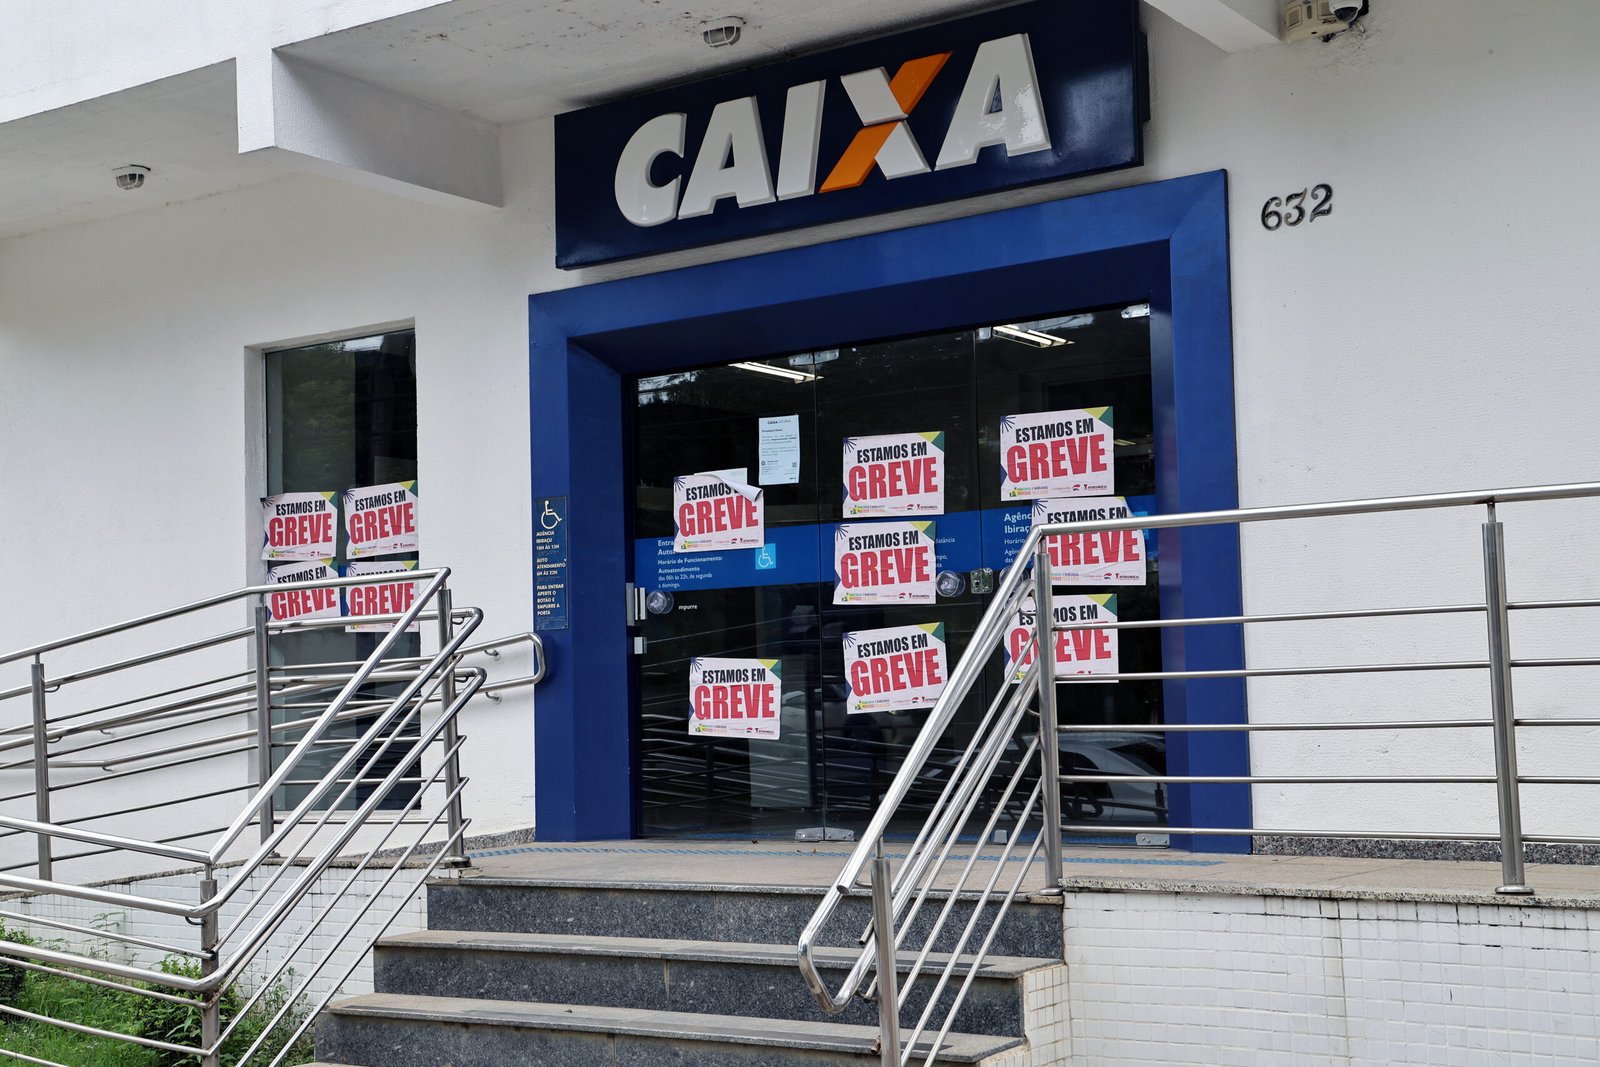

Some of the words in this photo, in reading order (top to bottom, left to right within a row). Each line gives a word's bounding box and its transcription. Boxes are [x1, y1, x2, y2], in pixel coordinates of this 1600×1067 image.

[614, 32, 1052, 227] CAIXA
[1261, 183, 1333, 231] 632
[1016, 421, 1073, 443] ESTAMOS
[1076, 418, 1094, 434] EM
[856, 444, 908, 464] ESTAMOS
[910, 442, 927, 456] EM
[1007, 434, 1107, 484] GREVE
[686, 482, 731, 501] ESTAMOS
[849, 457, 938, 502] GREVE
[276, 501, 312, 516] ESTAMOS
[314, 500, 326, 511] EM
[355, 492, 392, 512] ESTAMOS
[394, 490, 406, 502] EM
[269, 512, 332, 547] GREVE
[350, 502, 415, 544] GREVE
[679, 495, 758, 537] GREVE
[1004, 512, 1032, 523] Agênc
[1004, 525, 1032, 533] Ibiraç
[1048, 508, 1102, 524] ESTAMOS
[849, 532, 900, 551] ESTAMOS
[902, 530, 919, 545] EM
[316, 566, 327, 579] EM
[841, 546, 930, 589] GREVE
[271, 588, 336, 620] GREVE
[350, 582, 414, 616] GREVE
[1018, 604, 1077, 626] ESMOS
[1080, 604, 1098, 620] EM
[857, 636, 909, 658] ESTAMOS
[911, 633, 928, 649] EM
[1010, 621, 1111, 666] GEVE
[702, 669, 749, 684] ESTAMOS
[751, 668, 765, 682] EM
[851, 648, 942, 697] GREVE
[695, 684, 775, 720] GREVE
